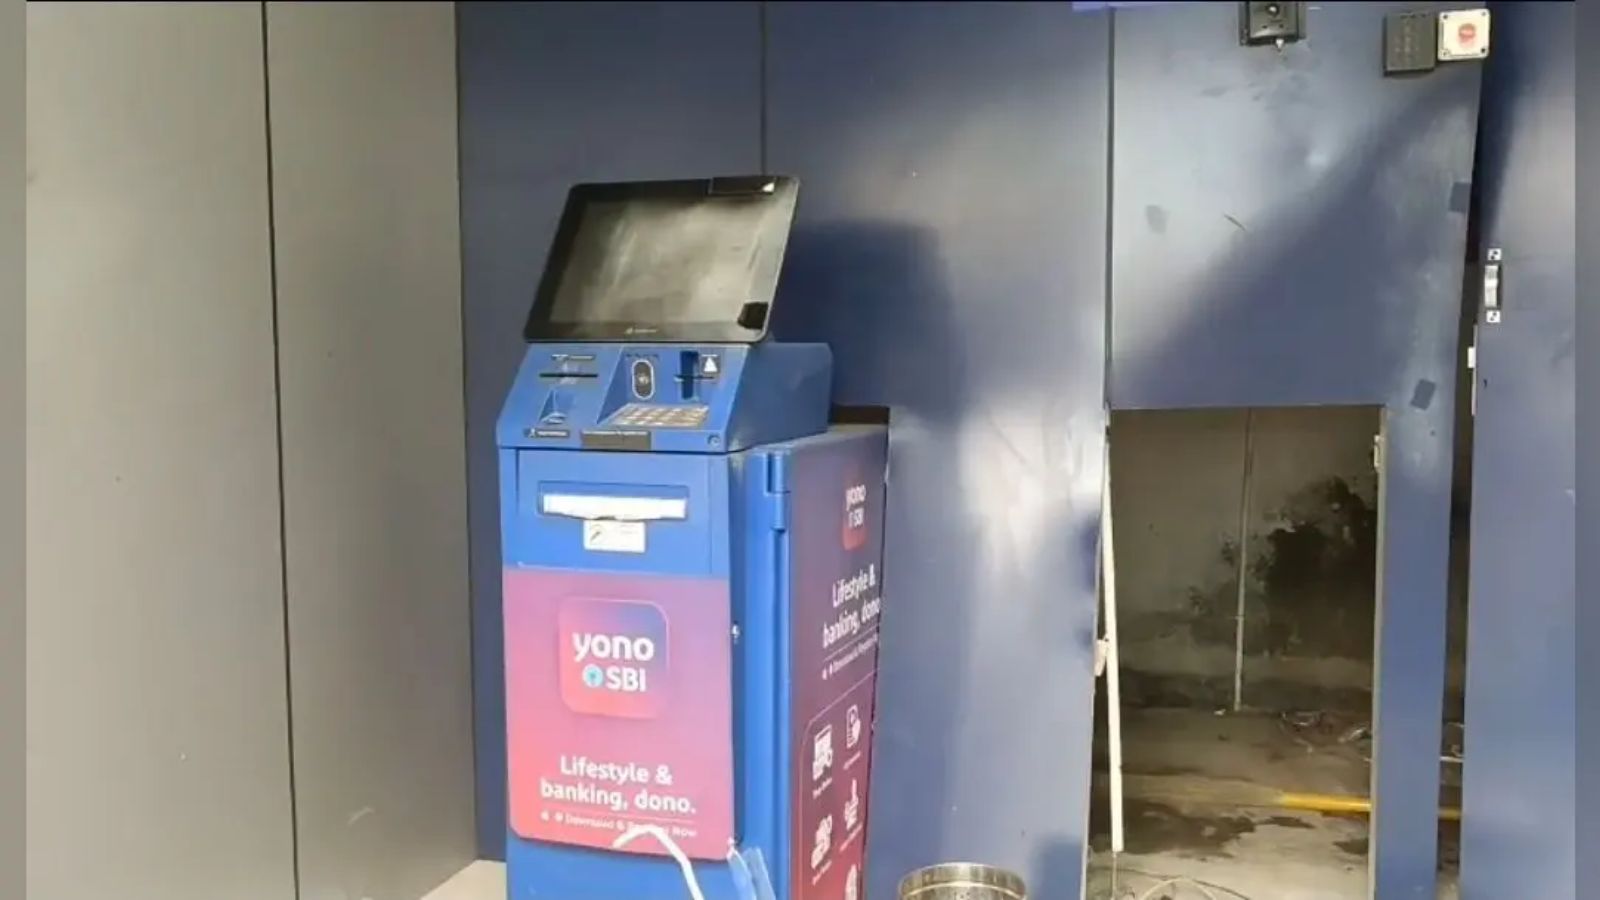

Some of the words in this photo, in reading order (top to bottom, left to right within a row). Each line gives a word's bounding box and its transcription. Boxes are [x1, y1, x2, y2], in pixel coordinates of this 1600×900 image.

[832, 568, 868, 608] Lifestyle
[572, 632, 654, 662] yono
[606, 666, 646, 692] SBI
[560, 755, 649, 785] Lifestyle
[655, 765, 672, 785] &
[540, 777, 628, 810] banking,
[634, 789, 696, 814] dono.
